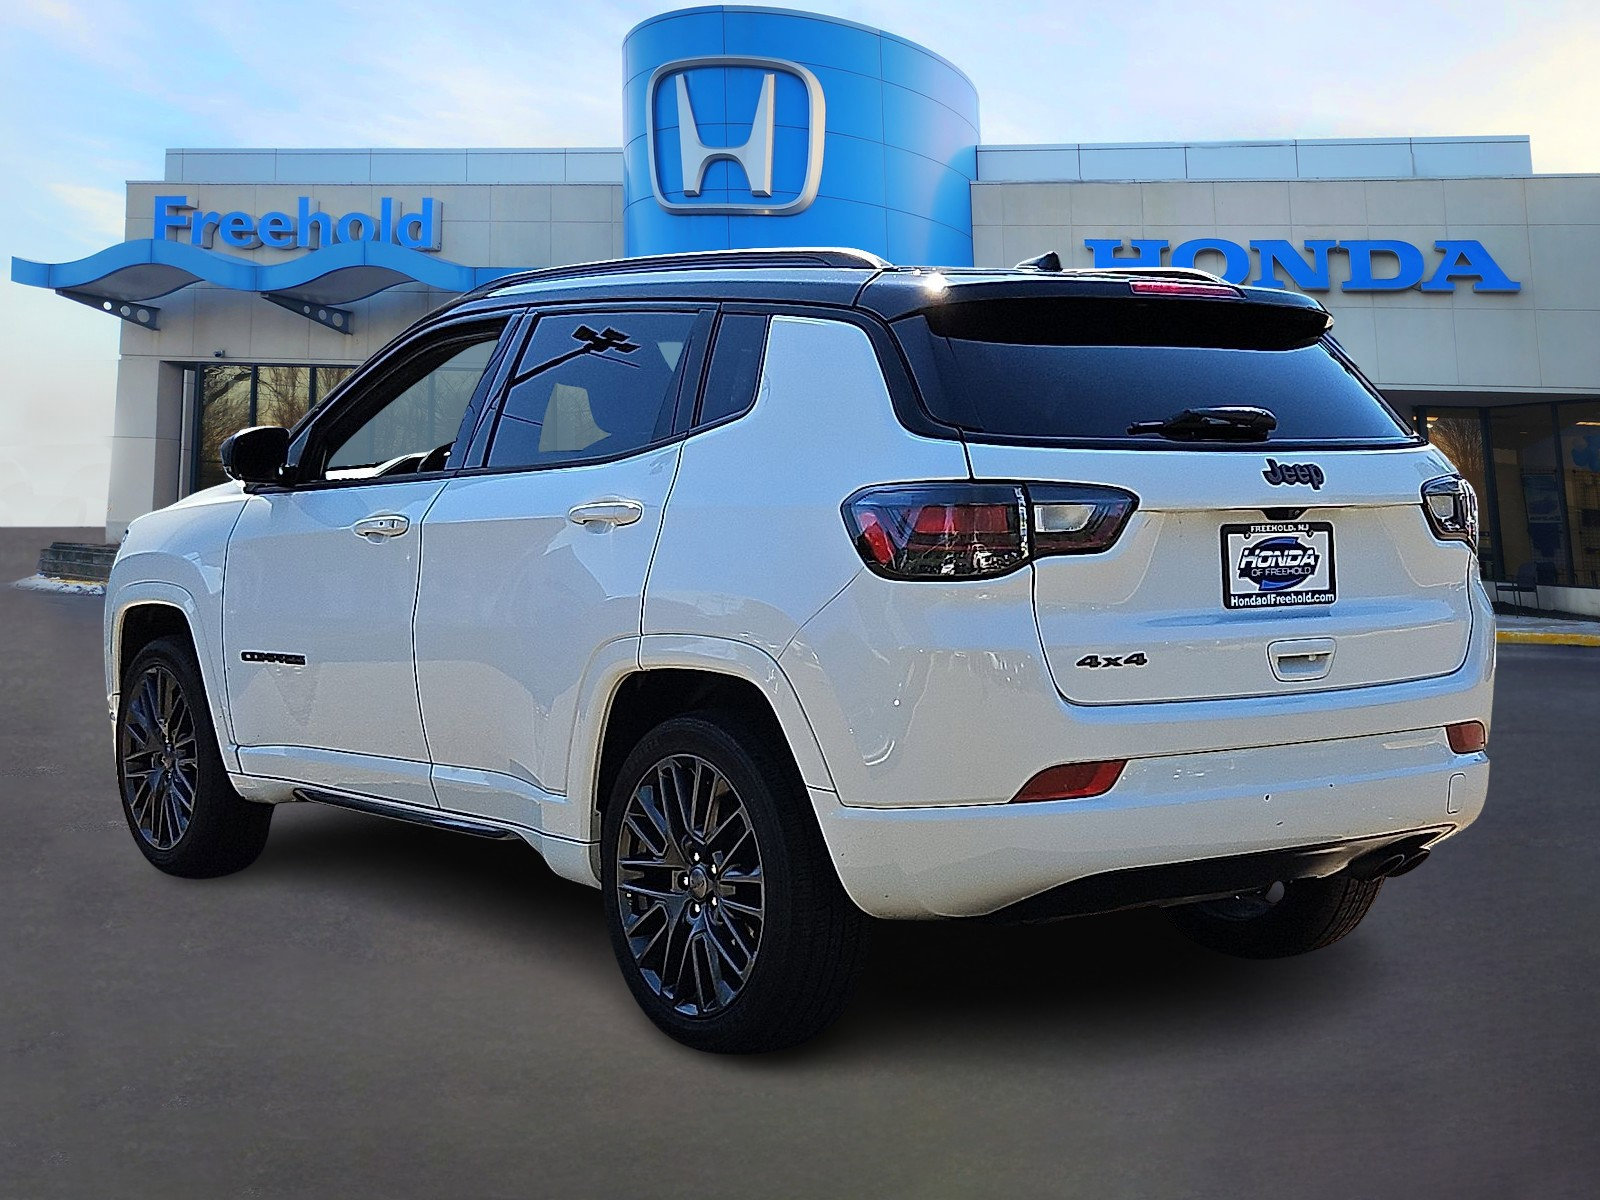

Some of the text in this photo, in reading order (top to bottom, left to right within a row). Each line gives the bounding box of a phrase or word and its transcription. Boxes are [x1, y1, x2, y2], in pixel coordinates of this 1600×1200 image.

[154, 195, 438, 249] Freehold
[1084, 237, 1521, 293] HONDA
[1262, 458, 1324, 490] Jeep
[1298, 523, 1309, 531] NJ
[1240, 548, 1315, 569] HONDA
[1251, 566, 1311, 577] OF FREEHOLD
[1230, 593, 1335, 607] HondaofFreehold.com
